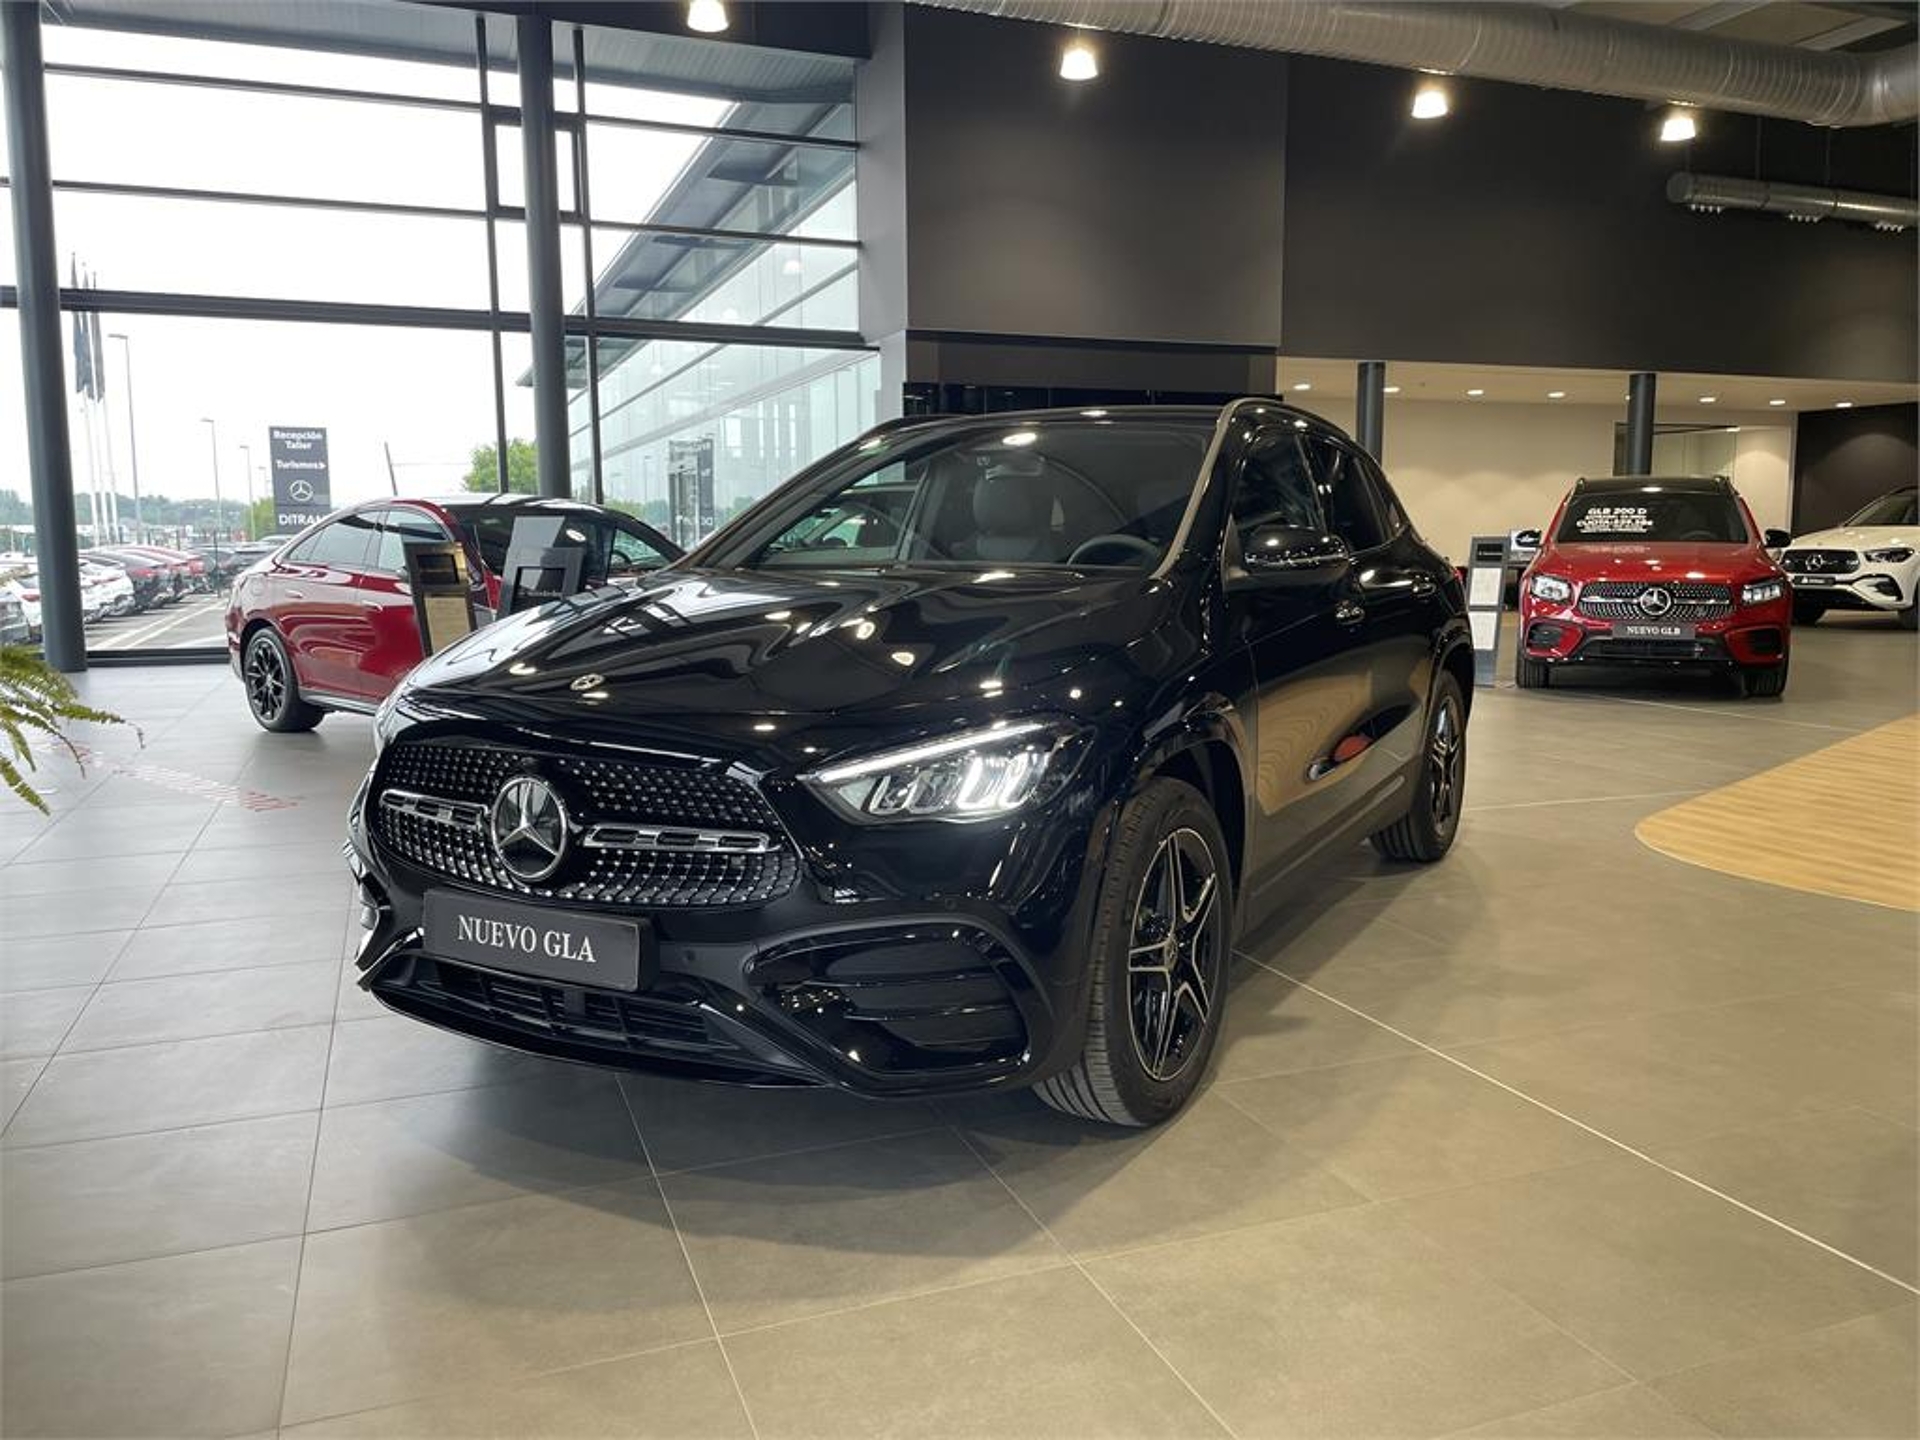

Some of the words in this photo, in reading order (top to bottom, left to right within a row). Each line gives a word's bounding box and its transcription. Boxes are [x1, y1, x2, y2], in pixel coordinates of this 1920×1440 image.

[285, 440, 312, 449] Taller
[1626, 626, 1660, 635] NUEVO
[1661, 627, 1681, 636] GLB
[457, 914, 538, 953] NUEVO
[543, 930, 597, 963] GLA
